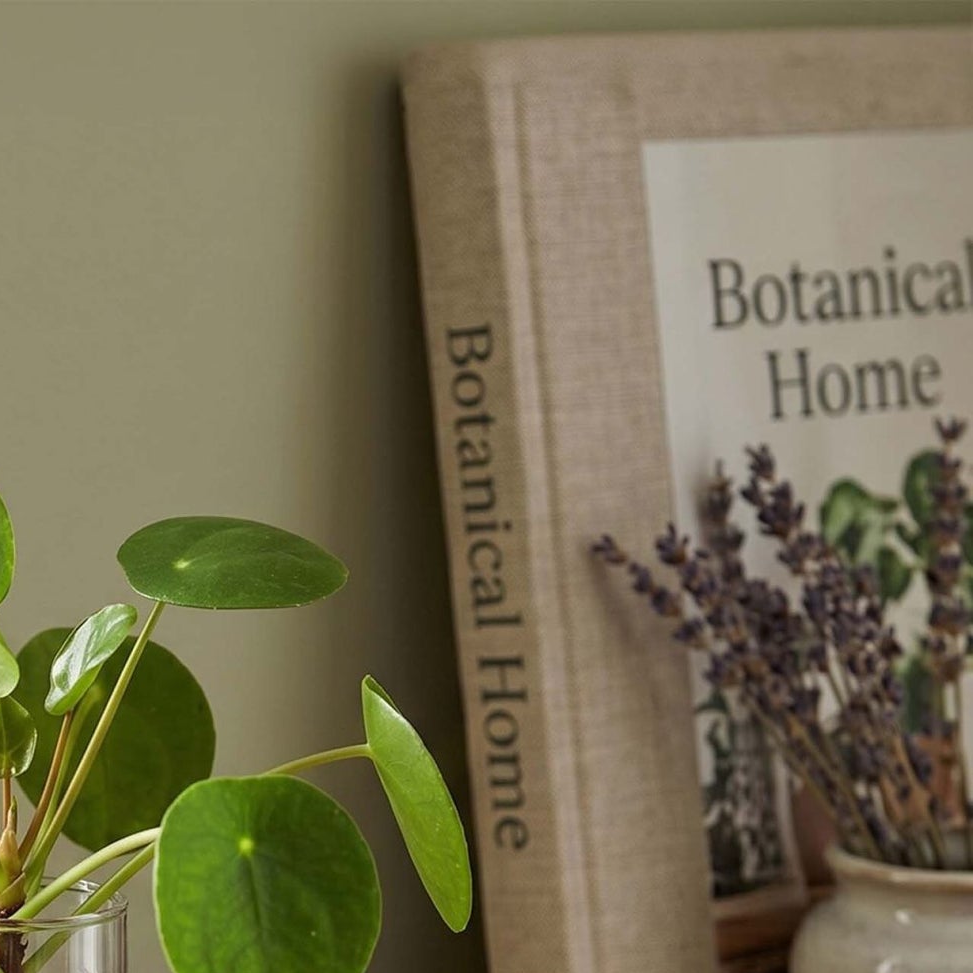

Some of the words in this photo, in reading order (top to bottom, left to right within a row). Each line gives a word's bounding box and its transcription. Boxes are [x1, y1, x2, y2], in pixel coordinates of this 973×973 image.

[446, 323, 522, 629] Botanical
[766, 347, 942, 420] Home
[477, 655, 530, 850] Home
